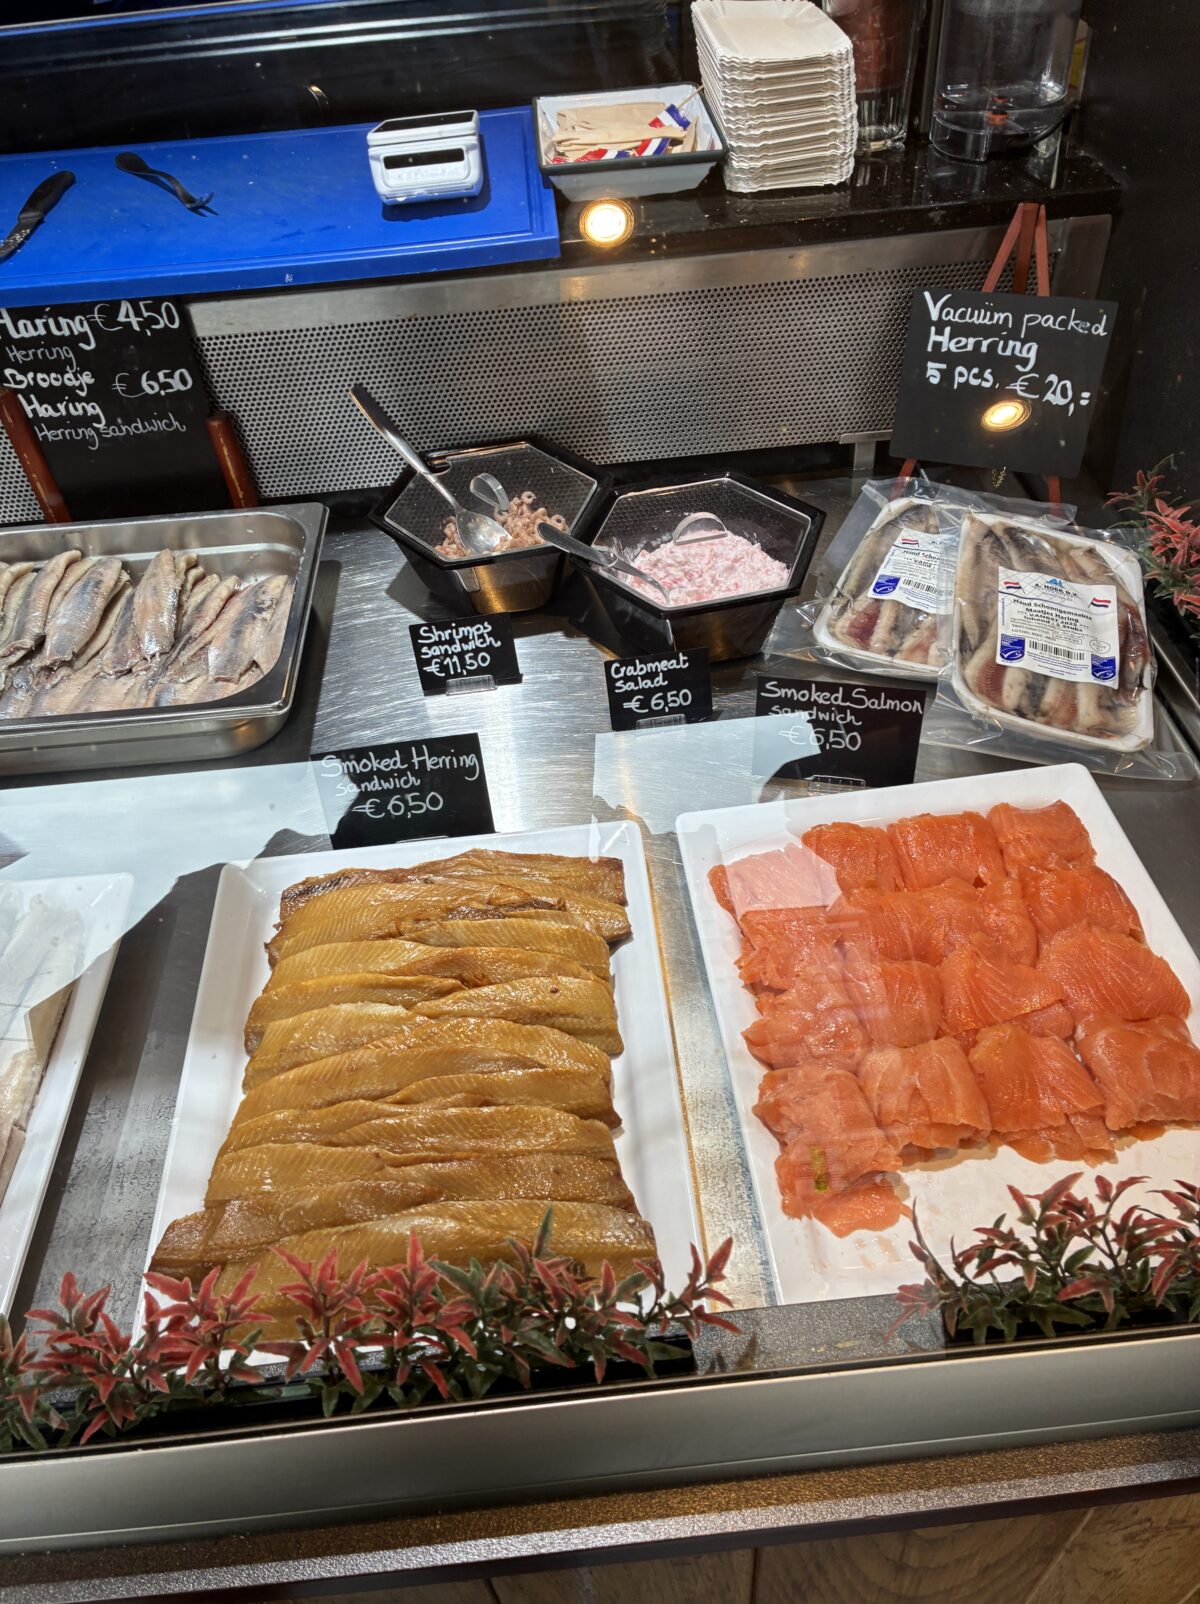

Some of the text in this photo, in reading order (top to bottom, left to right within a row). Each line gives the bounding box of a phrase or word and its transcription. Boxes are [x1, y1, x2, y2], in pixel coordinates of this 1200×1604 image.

[1020, 308, 1107, 339] packed
[5, 341, 77, 373] Herring
[927, 326, 1038, 372] Herring
[3, 366, 96, 397] Broodje
[926, 361, 947, 385] 5
[18, 395, 106, 428] Haring
[34, 412, 187, 450] Herring sandwich
[418, 621, 492, 644] Shrimps
[420, 633, 501, 659] sandwich
[610, 652, 690, 679] Crabmeat
[760, 681, 923, 714] Smoked Salmon
[321, 745, 480, 781] Smoked Herring
[335, 770, 421, 797] sandwich
